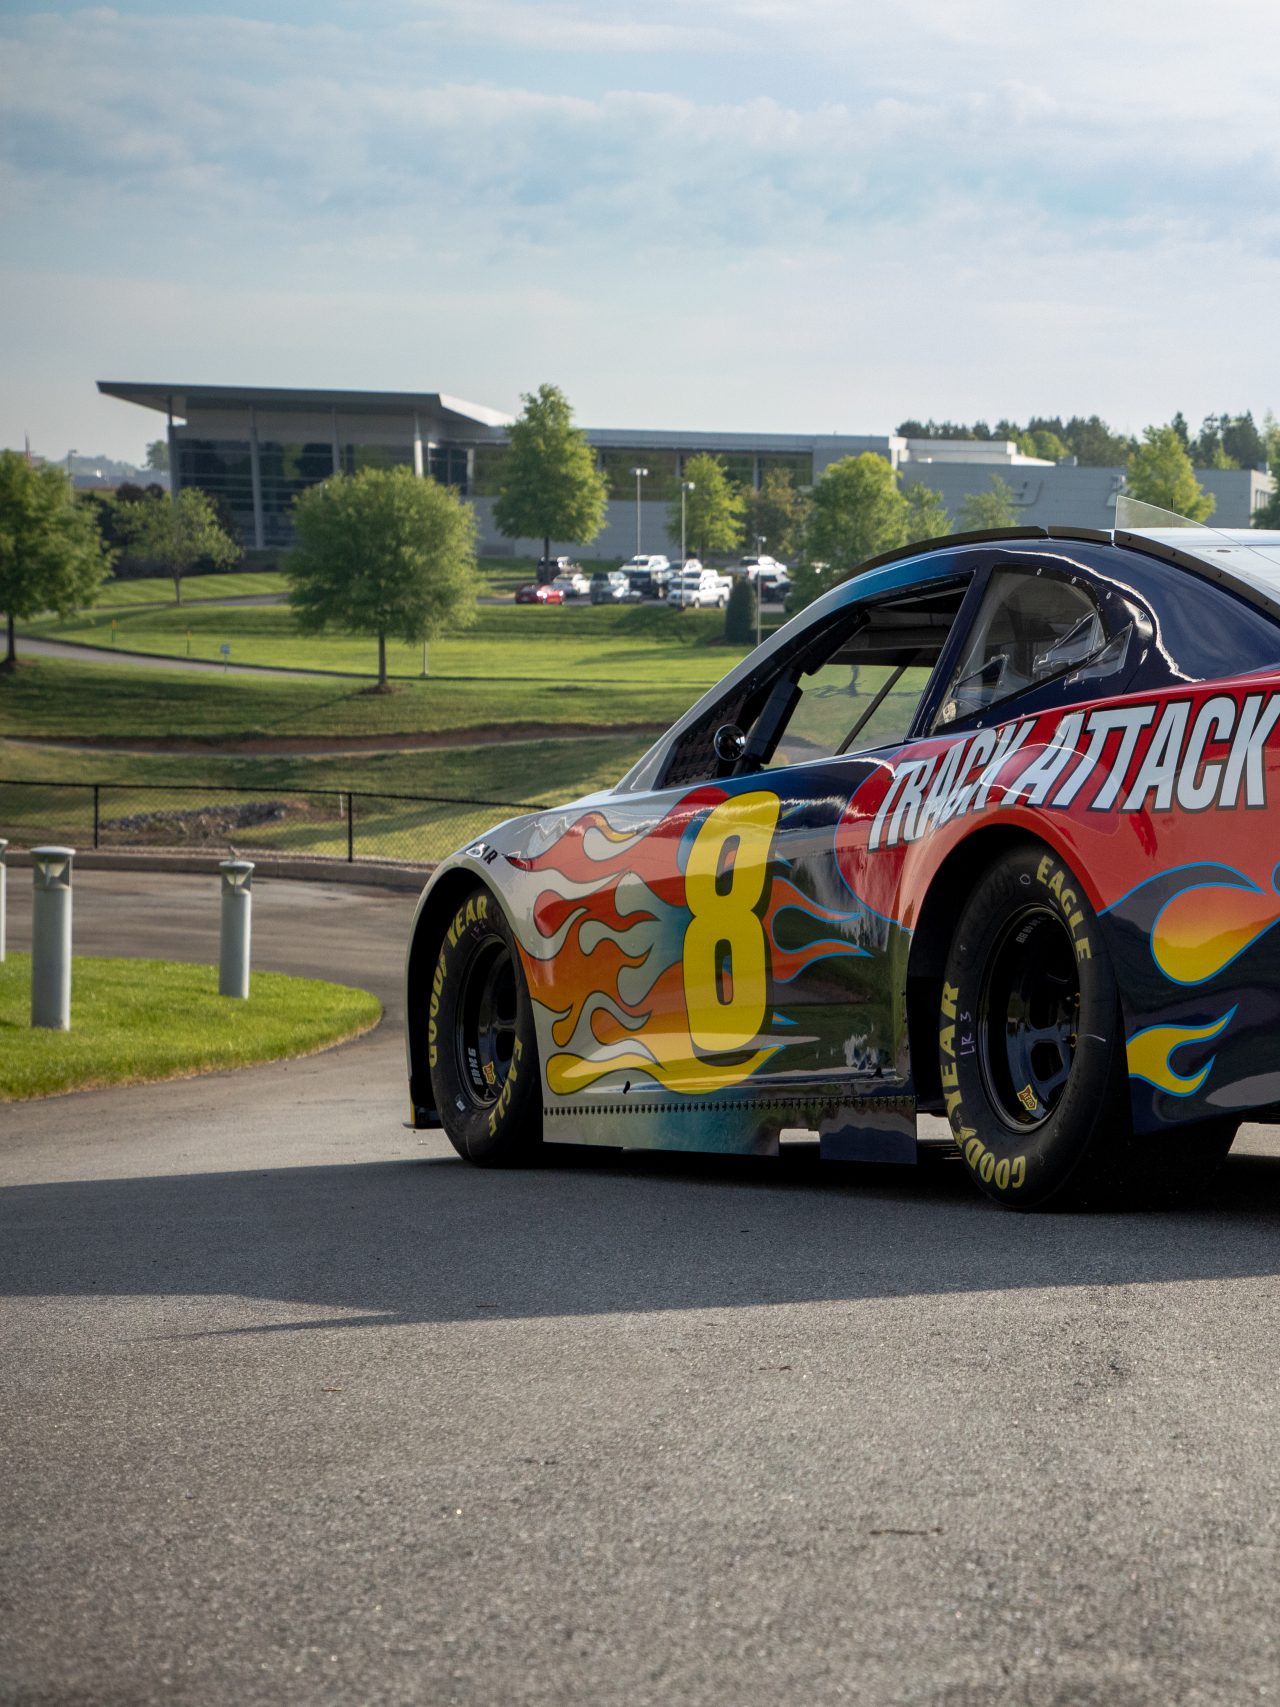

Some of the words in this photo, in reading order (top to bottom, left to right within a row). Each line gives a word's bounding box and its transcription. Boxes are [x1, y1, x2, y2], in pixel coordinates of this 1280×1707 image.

[867, 717, 1039, 852] TRACK
[683, 790, 780, 1062] 8
[1036, 855, 1092, 963] EAGLE
[960, 1032, 976, 1056] LR
